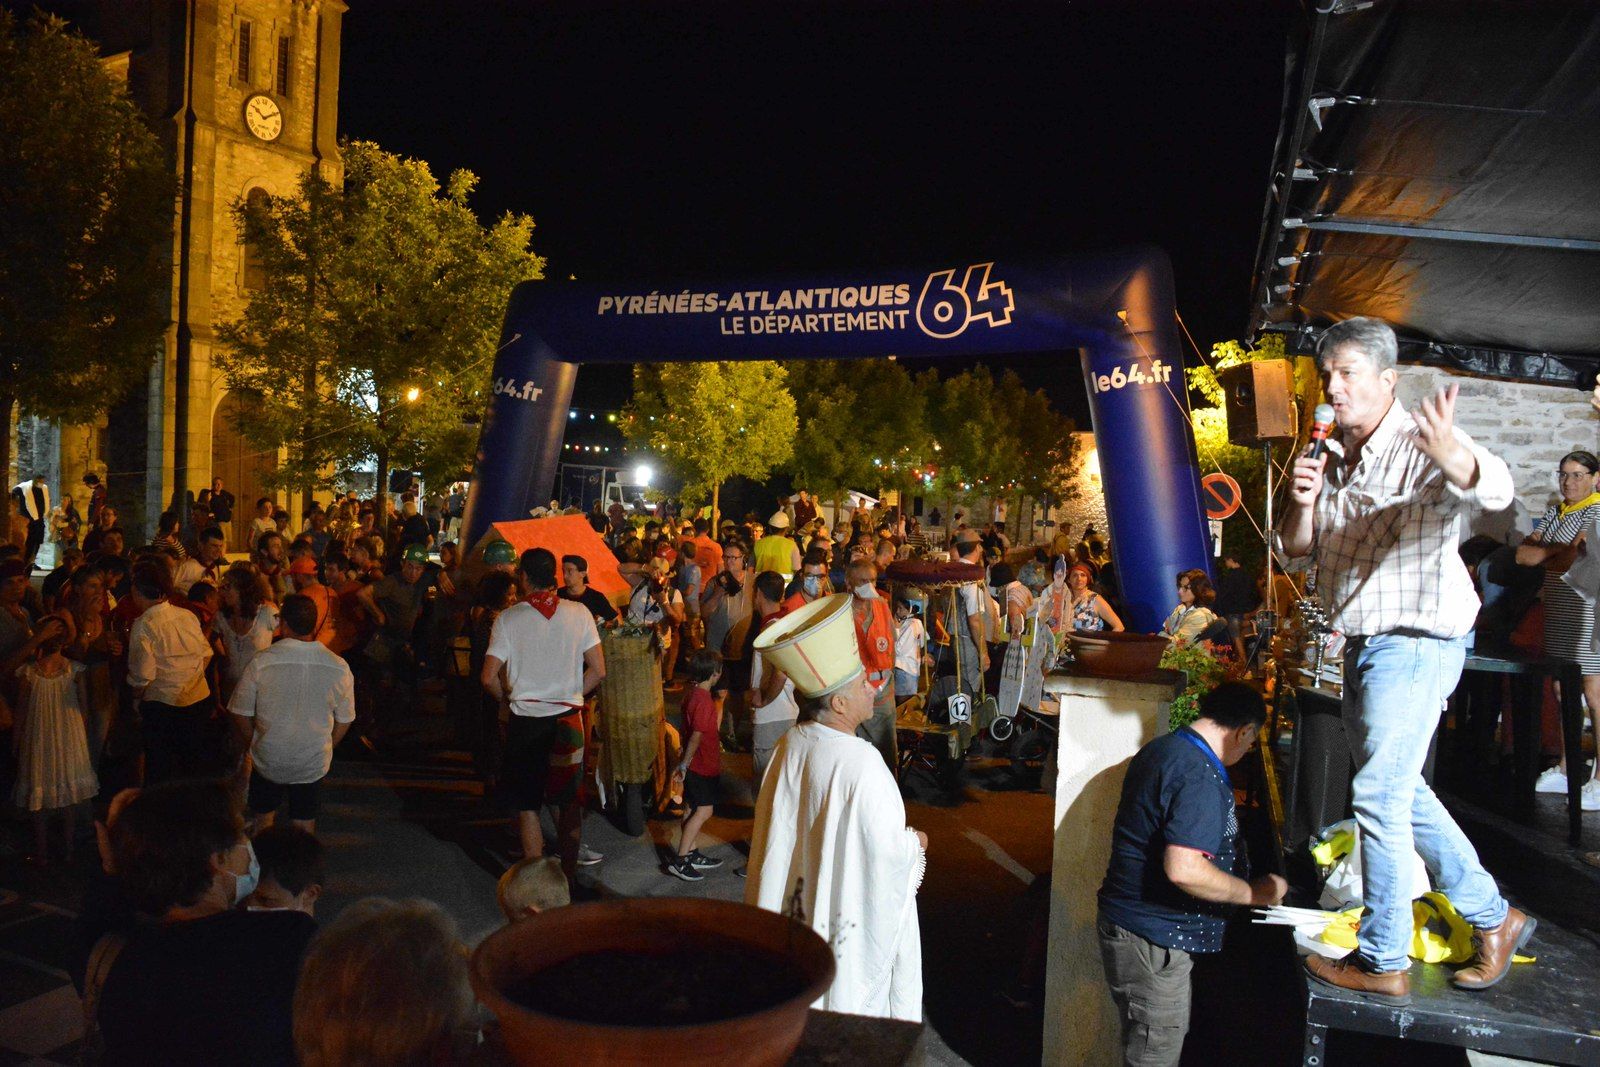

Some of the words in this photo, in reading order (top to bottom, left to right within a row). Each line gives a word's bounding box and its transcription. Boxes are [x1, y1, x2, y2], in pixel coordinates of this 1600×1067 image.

[598, 283, 910, 315] PYRÉNÉES-ATLANTIQUES
[916, 262, 1015, 339] 64
[720, 317, 747, 335] LE
[750, 309, 910, 335] DÉPARTEMENT
[1092, 360, 1172, 394] le64.fr
[952, 701, 968, 716] 12
